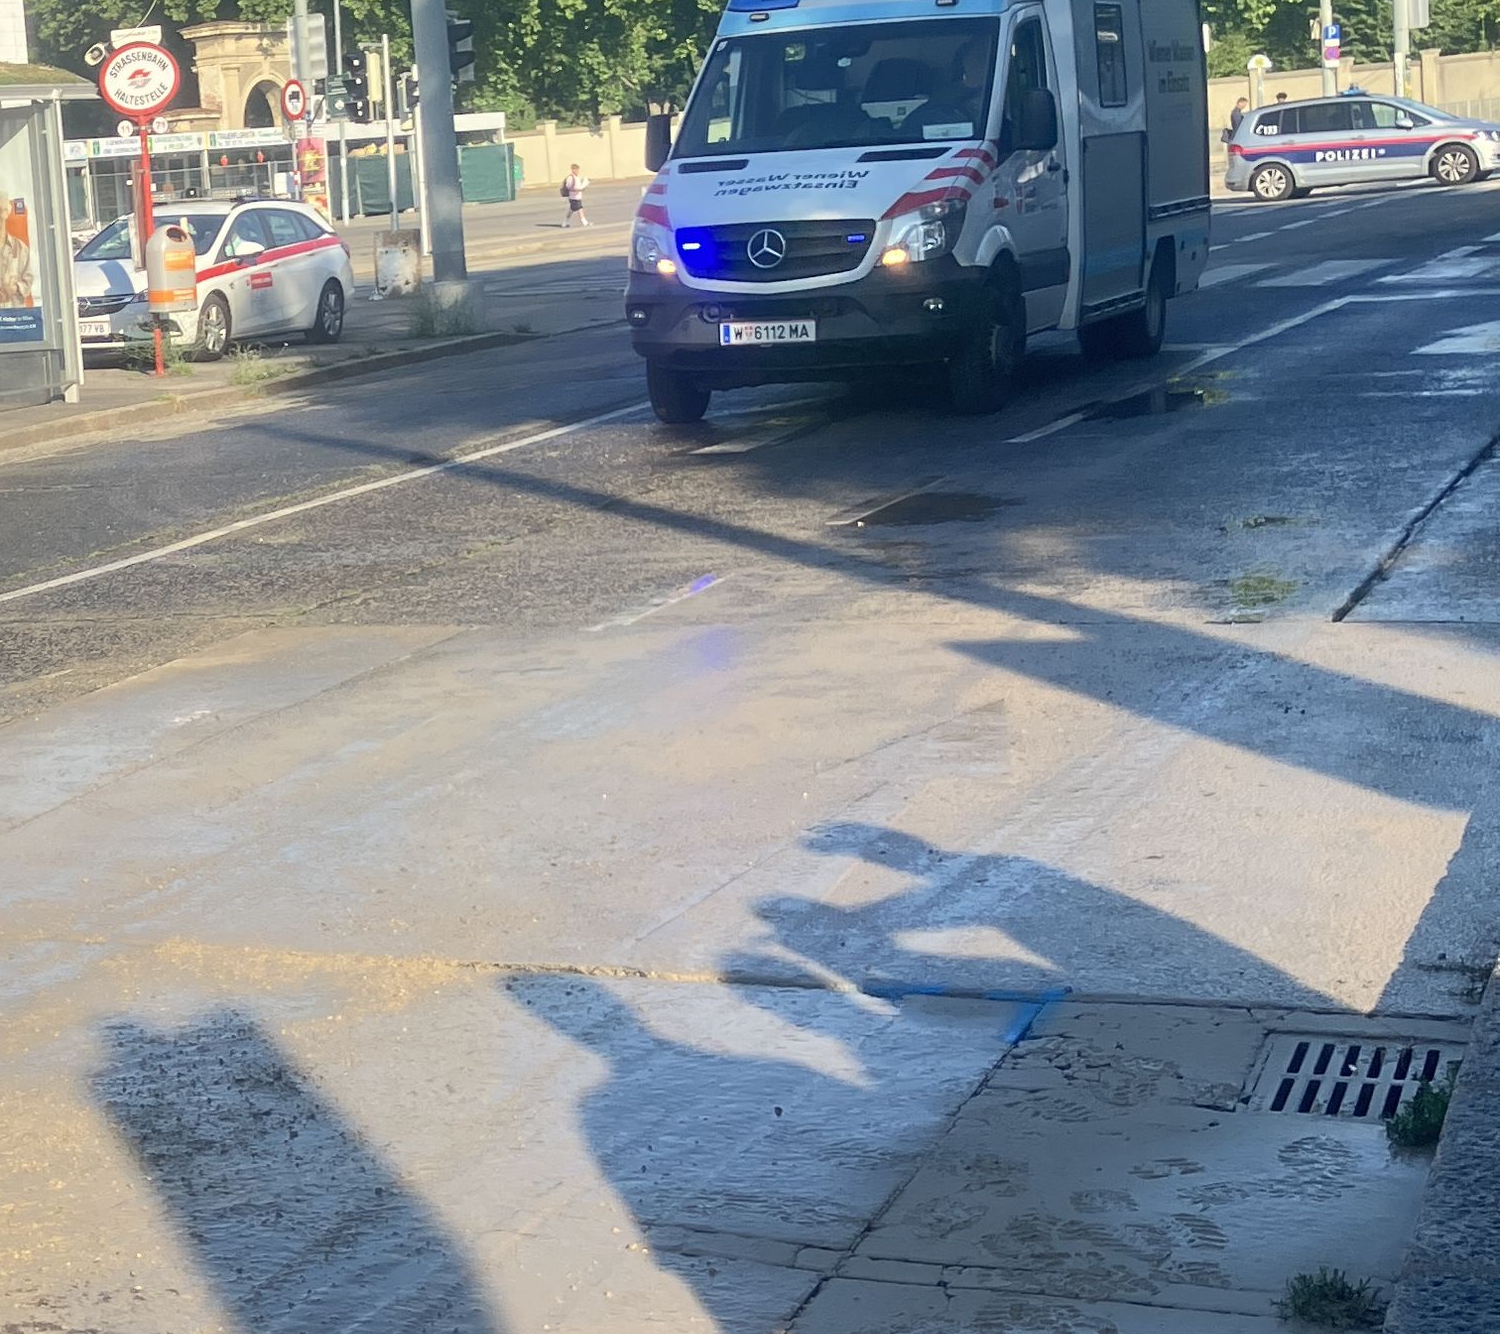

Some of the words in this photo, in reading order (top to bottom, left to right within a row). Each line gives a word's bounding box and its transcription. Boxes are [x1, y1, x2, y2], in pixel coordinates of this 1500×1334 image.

[109, 51, 169, 78] STRASSENBAHN
[114, 82, 168, 106] HALTESTELLE
[1264, 125, 1278, 135] 133
[1315, 148, 1376, 162] POLIZEI
[734, 325, 743, 341] W
[754, 324, 786, 340] 6112
[788, 323, 810, 339] MA
